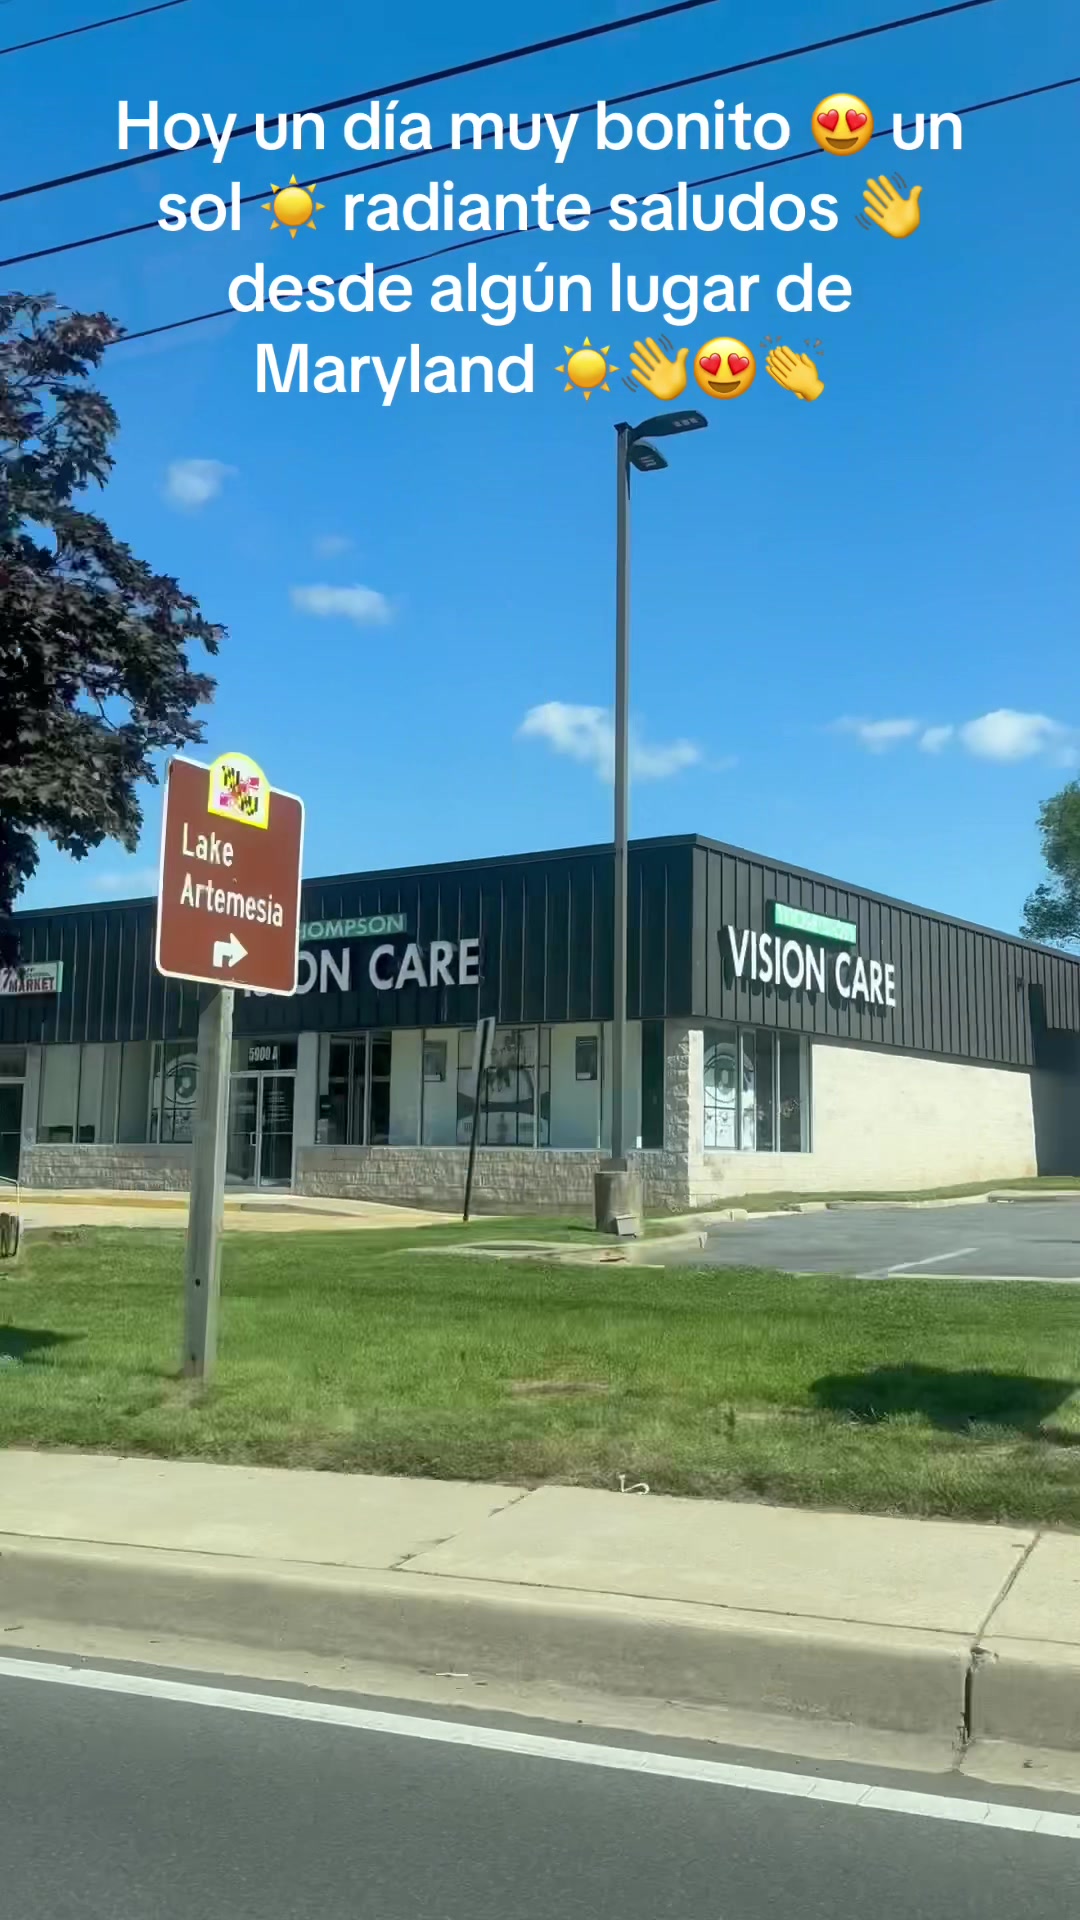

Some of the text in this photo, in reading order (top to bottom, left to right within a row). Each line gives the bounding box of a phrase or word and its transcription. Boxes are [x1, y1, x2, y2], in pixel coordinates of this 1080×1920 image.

[181, 822, 234, 867] Lake
[180, 872, 284, 928] Artemesia
[368, 938, 480, 991] CARE
[727, 925, 896, 1008] VISION CARE
